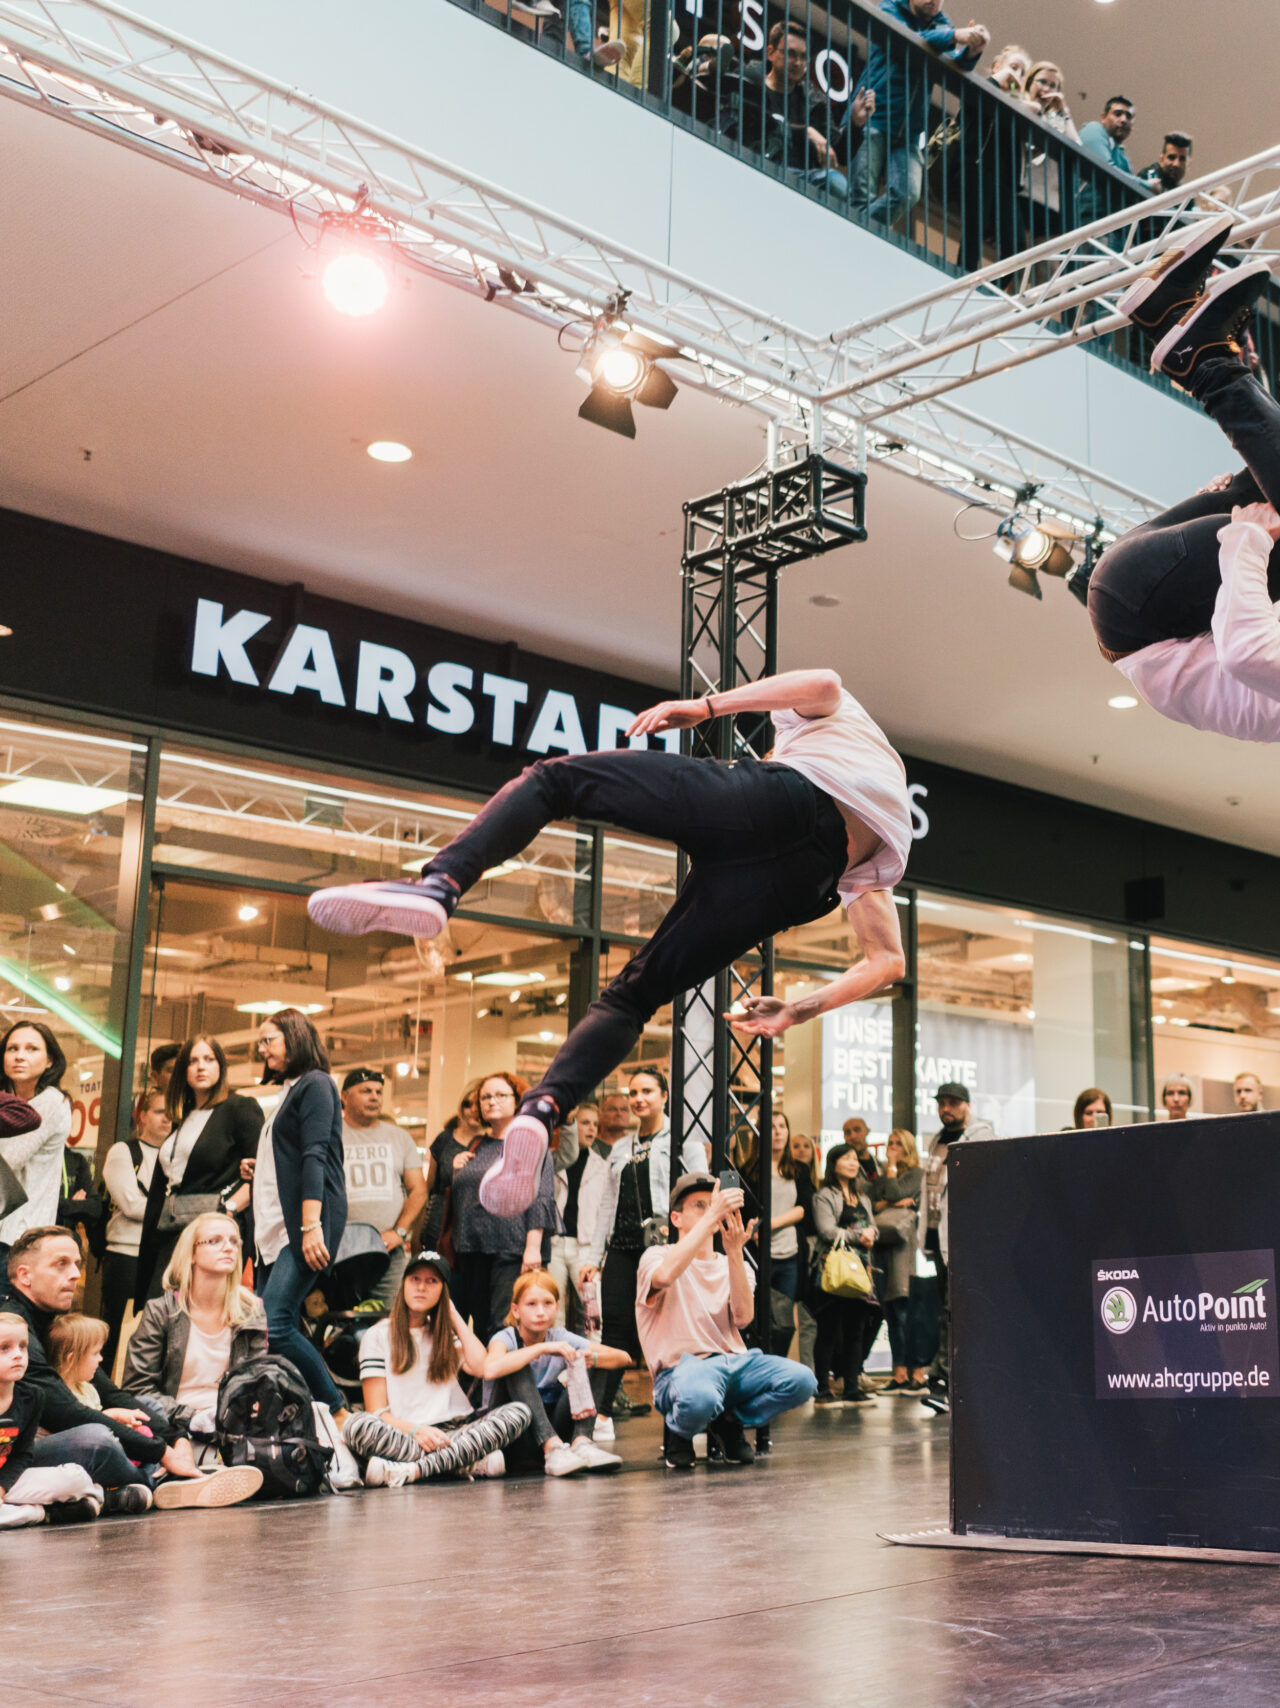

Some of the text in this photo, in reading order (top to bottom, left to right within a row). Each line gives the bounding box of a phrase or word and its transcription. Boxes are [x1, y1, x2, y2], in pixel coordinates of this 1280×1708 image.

[832, 1076, 878, 1112] FÜR
[345, 1145, 388, 1160] ZERO
[350, 1162, 387, 1187] 00
[1097, 1269, 1139, 1282] ŠKODA
[1142, 1287, 1267, 1323] AutoPoint
[1200, 1321, 1267, 1333] Aktiv in punkto Auto!
[1107, 1365, 1270, 1393] www.ahcgruppe.de
